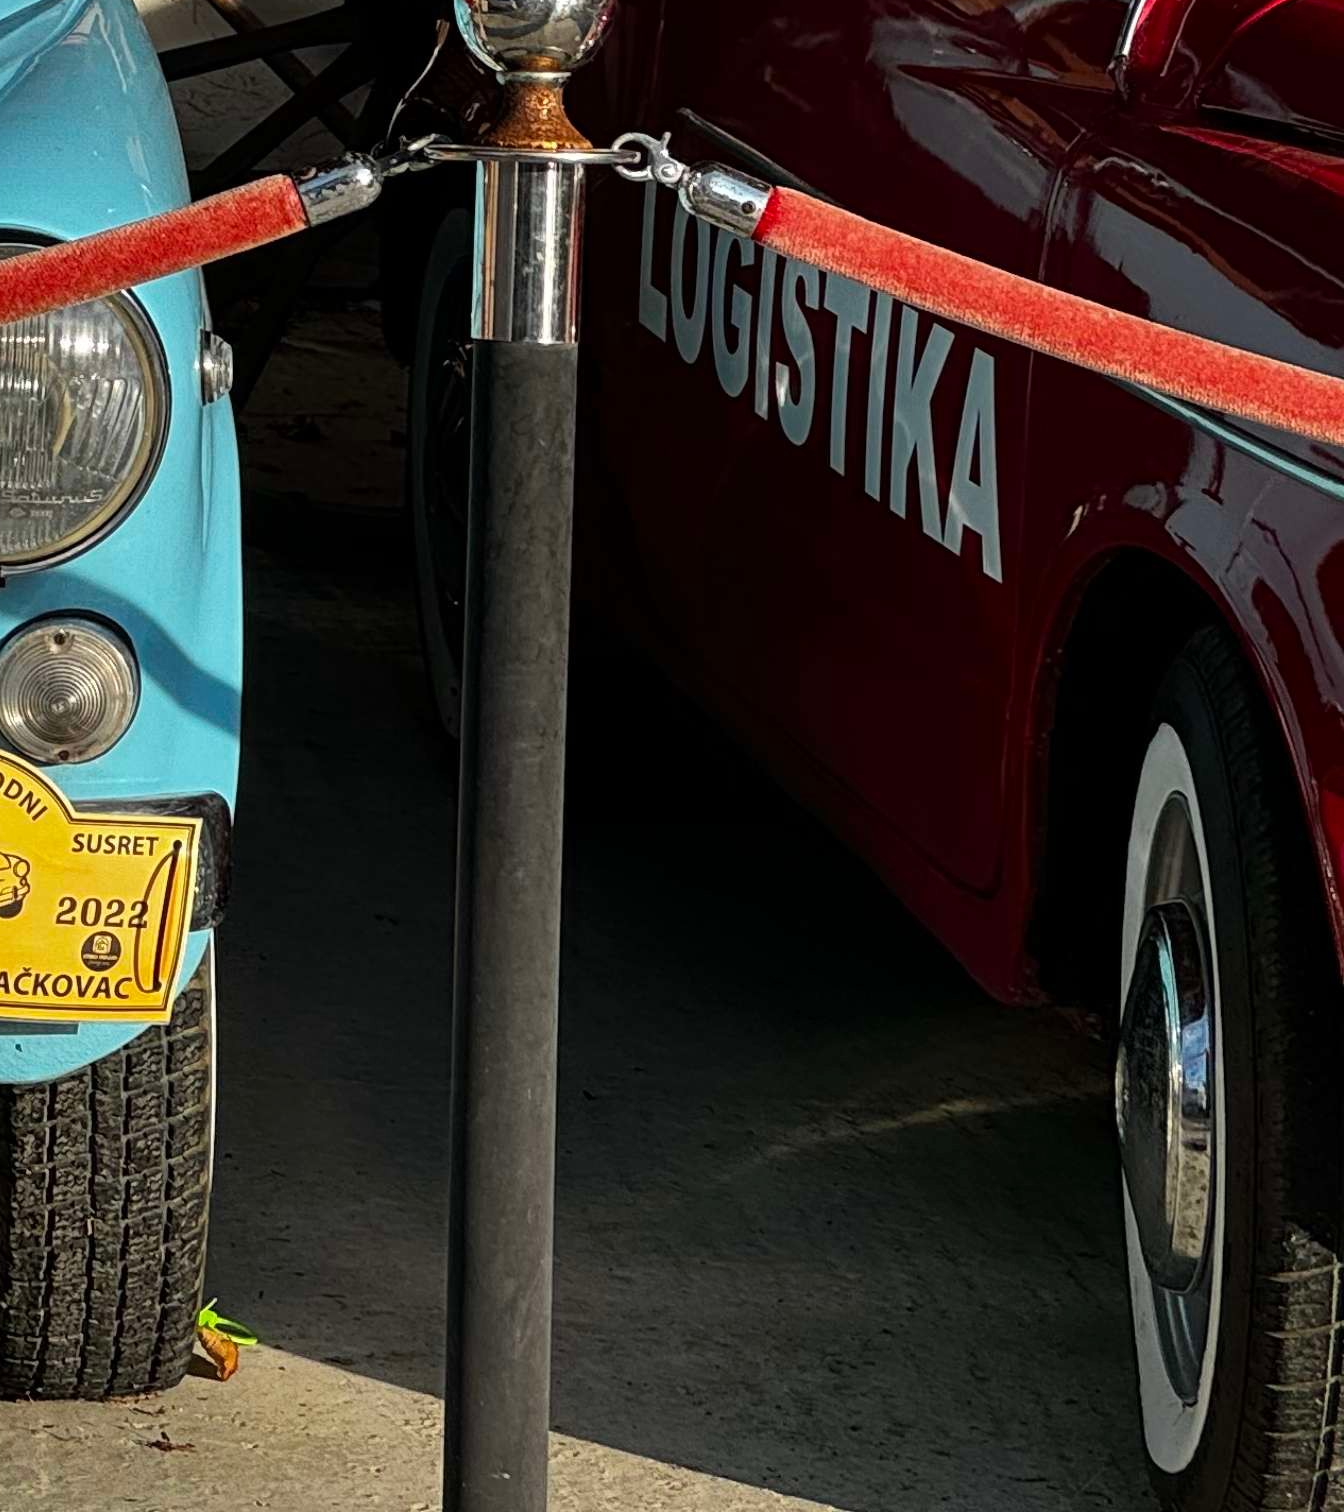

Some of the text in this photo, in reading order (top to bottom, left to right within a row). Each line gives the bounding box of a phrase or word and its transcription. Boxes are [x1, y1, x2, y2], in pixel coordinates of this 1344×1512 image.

[638, 180, 1003, 584] LOGISTIKA
[71, 832, 160, 858] SUSRET
[55, 896, 150, 929] 2022
